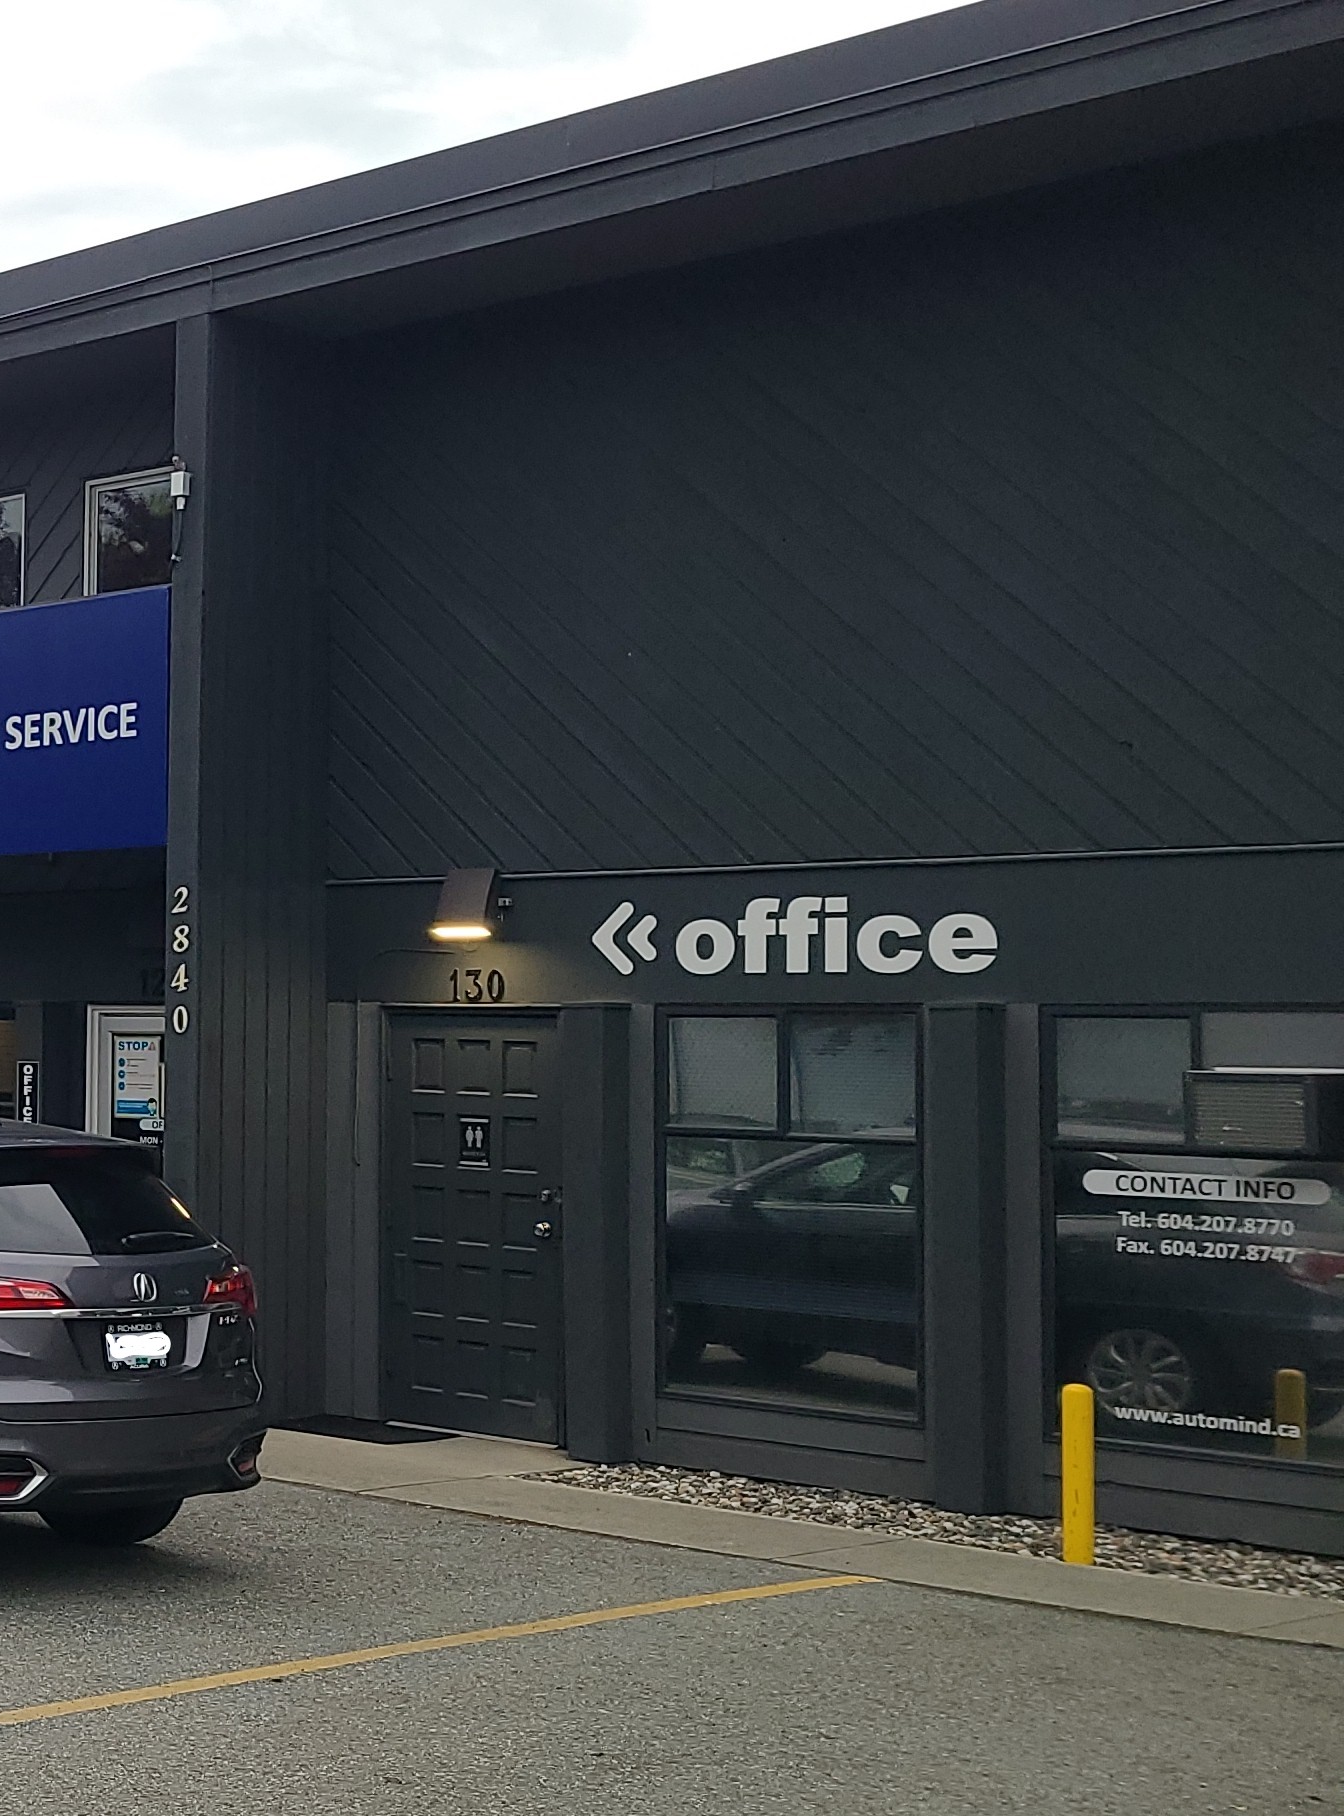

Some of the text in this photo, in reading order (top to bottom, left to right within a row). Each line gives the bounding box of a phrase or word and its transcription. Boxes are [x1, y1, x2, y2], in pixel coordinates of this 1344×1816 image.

[4, 702, 138, 750] SERVICE
[675, 896, 999, 975] office
[170, 886, 190, 1034] 2840
[449, 968, 505, 1002] 130
[118, 1041, 149, 1051] STOP
[22, 1064, 34, 1124] OFFICE
[139, 1136, 158, 1145] MON
[1115, 1174, 1296, 1201] CONTACT INFO
[1116, 1211, 1296, 1237] Tel. 604.207.8770
[1116, 1236, 1297, 1264] Fax. 604.207.8747
[117, 1323, 153, 1332] RICHMOND
[1113, 1406, 1301, 1439] www.automind.ca
